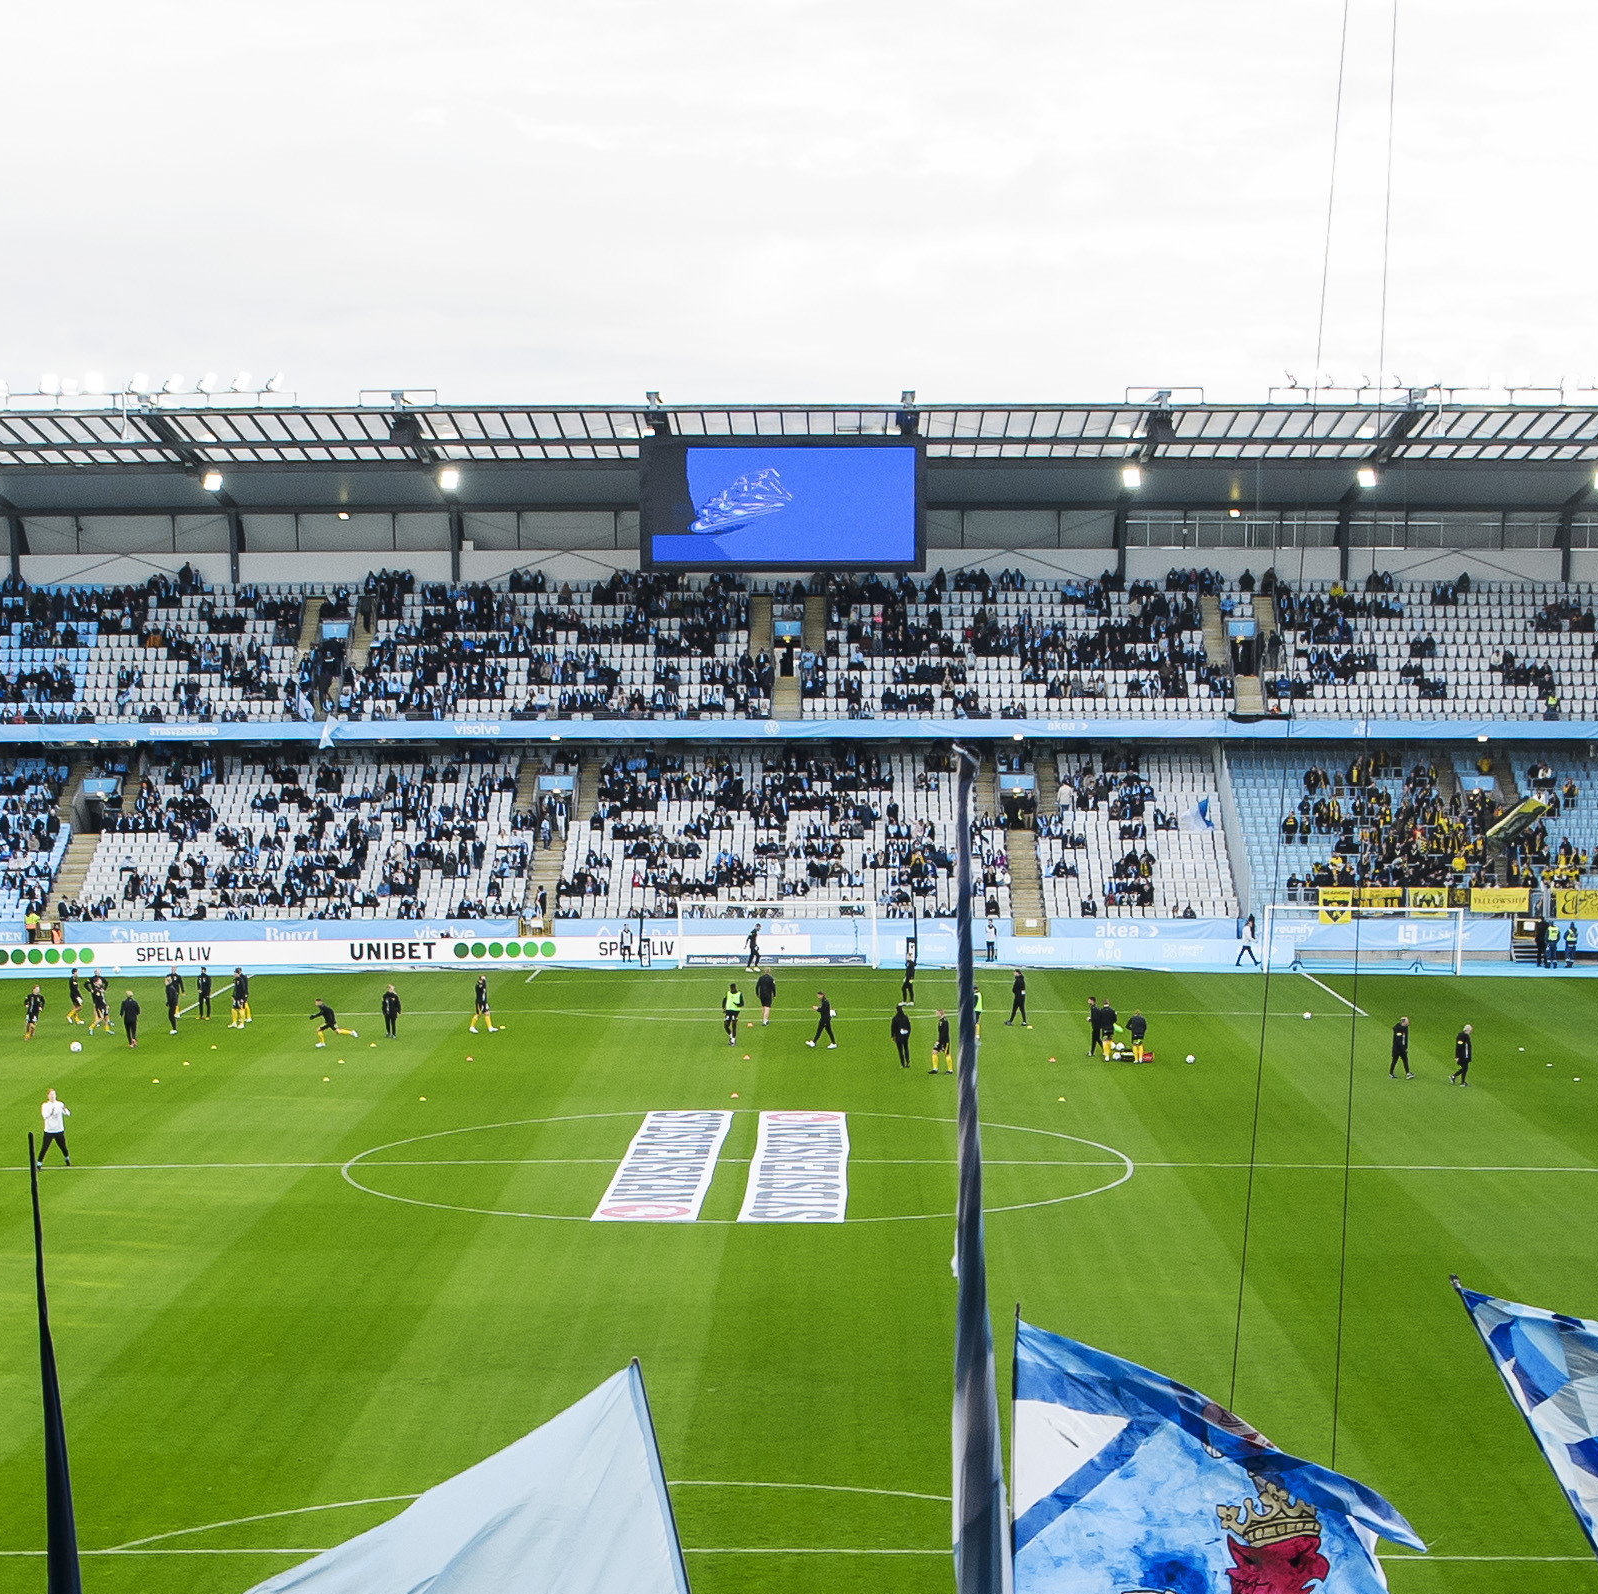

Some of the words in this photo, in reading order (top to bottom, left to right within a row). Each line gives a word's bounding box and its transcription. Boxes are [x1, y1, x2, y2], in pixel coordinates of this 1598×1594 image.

[453, 724, 501, 736] visolve
[1095, 923, 1139, 938] akea
[136, 947, 184, 962] SPELA
[189, 946, 211, 961] LIV
[350, 942, 437, 961] UNIBET
[654, 941, 675, 956] LIV
[608, 1112, 725, 1203] SYDSVENSKAN
[749, 1123, 843, 1220] SYDSVENSKAN
